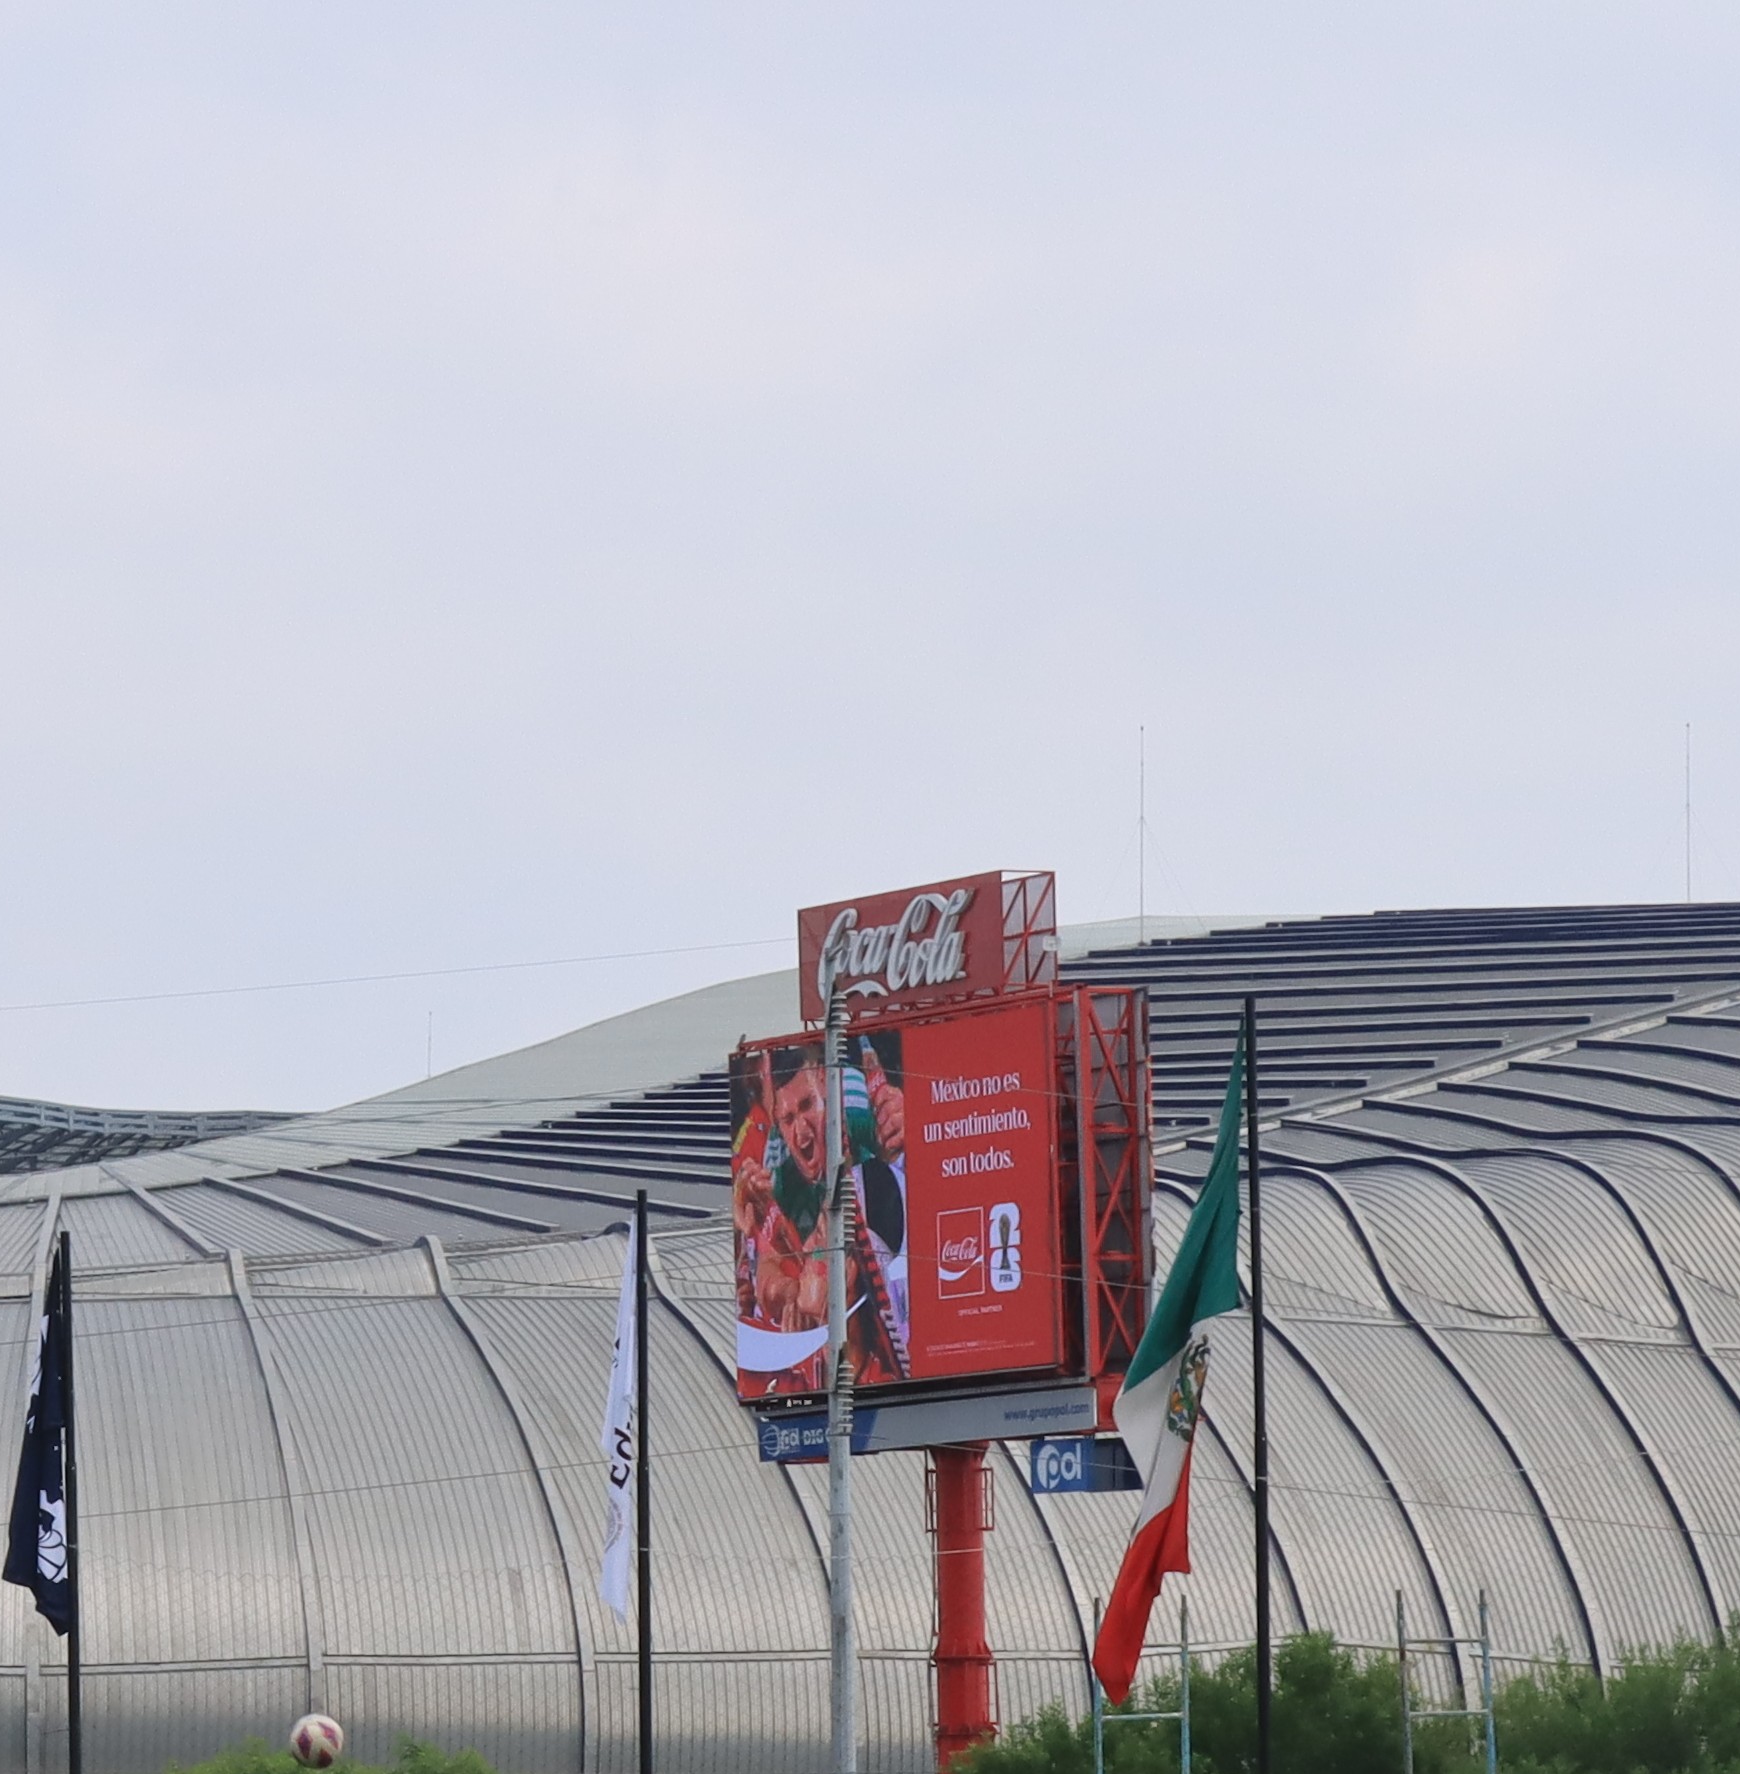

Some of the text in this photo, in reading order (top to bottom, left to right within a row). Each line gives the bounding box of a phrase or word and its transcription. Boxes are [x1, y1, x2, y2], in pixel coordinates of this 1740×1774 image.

[931, 1072, 1020, 1104] México no es
[924, 1107, 1031, 1143] un sentimiento,
[942, 1146, 1014, 1178] son todos.
